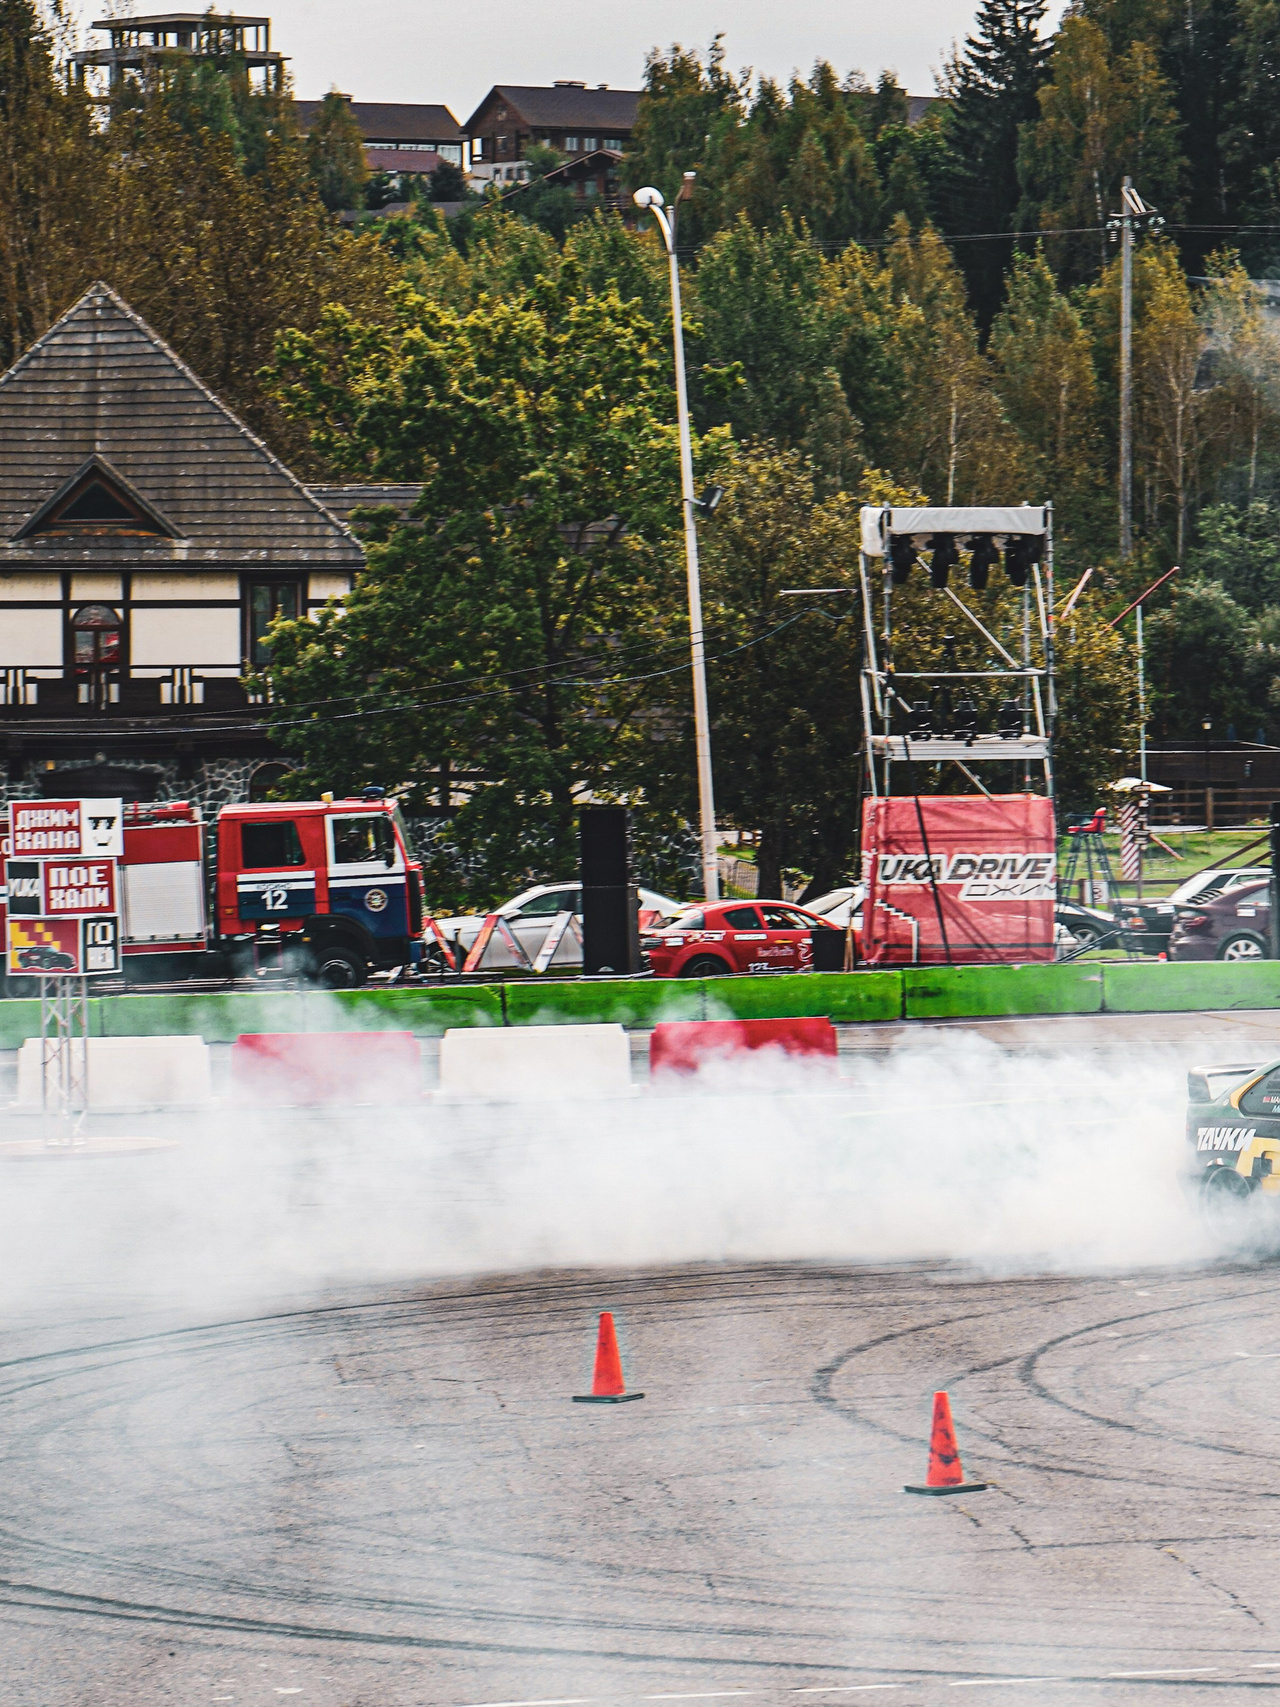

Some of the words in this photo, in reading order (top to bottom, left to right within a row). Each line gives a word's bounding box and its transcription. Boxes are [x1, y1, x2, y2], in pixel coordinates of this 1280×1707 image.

[15, 809, 79, 830] ДЖИМ
[15, 830, 79, 849] ХАНА
[48, 865, 108, 888] ПОЕ
[947, 858, 1053, 880] DRIVE
[49, 887, 109, 909] ХАЛИ
[261, 890, 288, 910] 12
[1198, 1127, 1256, 1151] ТАЧКИ
